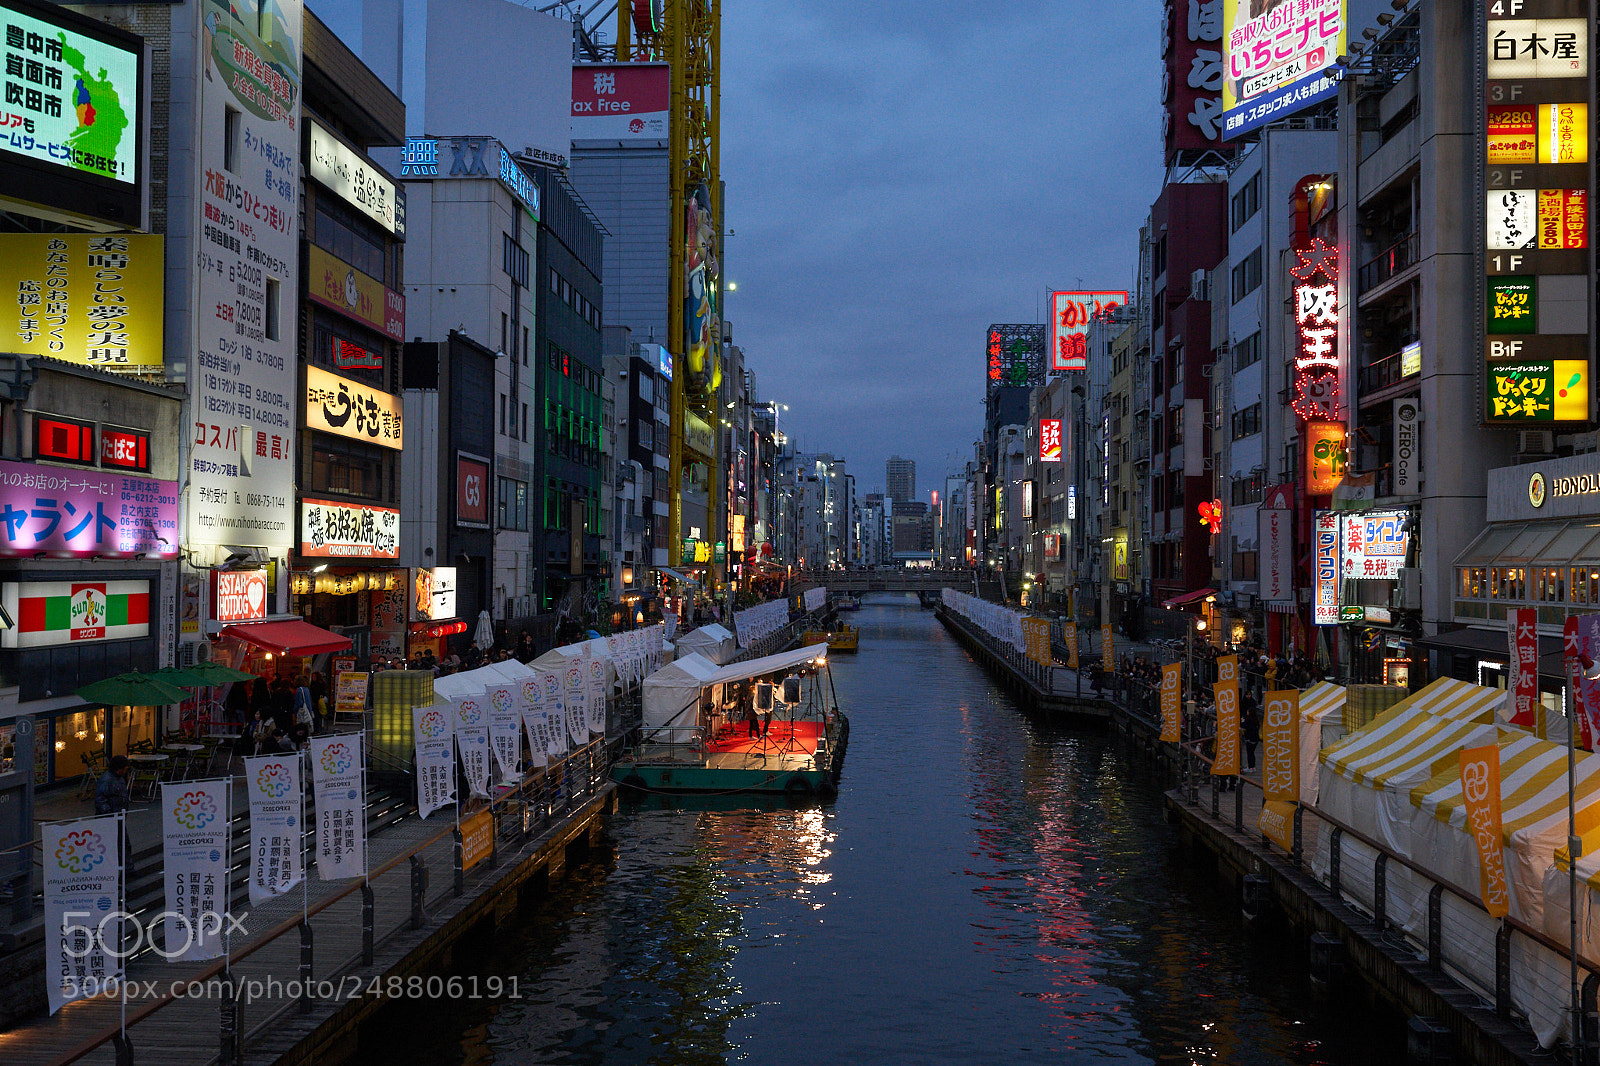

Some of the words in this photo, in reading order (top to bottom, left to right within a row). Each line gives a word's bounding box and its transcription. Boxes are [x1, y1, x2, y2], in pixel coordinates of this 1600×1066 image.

[6, 24, 63, 62] 豊中市
[1231, 9, 1339, 78] いちごナビ
[1494, 30, 1579, 60] 白木屋
[6, 52, 63, 90] 箕面市
[594, 72, 615, 94] 税
[1246, 70, 1283, 94] いちごナビ
[1285, 61, 1302, 77] 求人
[5, 81, 62, 118] 吹田市
[598, 99, 630, 111] Free
[1492, 85, 1523, 100] 3F
[1560, 107, 1574, 160] 鳥貴族
[1491, 170, 1523, 186] 2F
[1539, 198, 1562, 218] 酒場
[1565, 196, 1585, 248] 豊後高田どり
[1543, 222, 1558, 246] 280
[1492, 255, 1523, 271] 1F
[45, 238, 69, 352] あなたのお店づくり
[86, 237, 130, 364] 素晴らしい夢の実現
[1495, 292, 1528, 305] びっくり
[17, 280, 42, 344] 応援します
[216, 302, 234, 323] 土日祝
[1493, 305, 1530, 319] ドンキー
[1287, 237, 1339, 421] 大阪王将
[1490, 340, 1523, 357] B1F
[1495, 375, 1546, 397] びっくり
[323, 382, 381, 437] うなぎ
[1493, 396, 1550, 418] ドンキー
[101, 437, 136, 461] たばこ
[195, 422, 238, 452] コスパ
[1399, 424, 1412, 460] ZERO
[121, 478, 160, 494] 玉屋町本店
[121, 492, 176, 505] 06-6212-3013
[199, 487, 228, 504] 予約受付
[465, 474, 480, 507] G3
[1552, 474, 1600, 497] HONOL
[0, 498, 117, 544] ャラント
[121, 505, 159, 518] 島之内支店
[325, 508, 374, 543] お好み焼
[1348, 524, 1362, 553] 薬
[1366, 520, 1405, 543] ダイコク
[329, 545, 372, 555] OKONOMIYAKI
[1319, 532, 1336, 580] ダイコク
[1363, 559, 1388, 576] 免税
[220, 574, 246, 595] 5STAR
[220, 595, 248, 616] HOTDOG
[1316, 606, 1338, 617] 免税
[79, 628, 97, 639] サンクス
[1168, 692, 1177, 736] HAPPY
[1216, 717, 1229, 770] WOMAN
[1227, 716, 1236, 769] HAPPY
[1266, 731, 1279, 794] WOMAN
[1277, 729, 1293, 793] HAPPY
[1472, 812, 1502, 905] WOMAN
[1479, 804, 1509, 899] HAPPY
